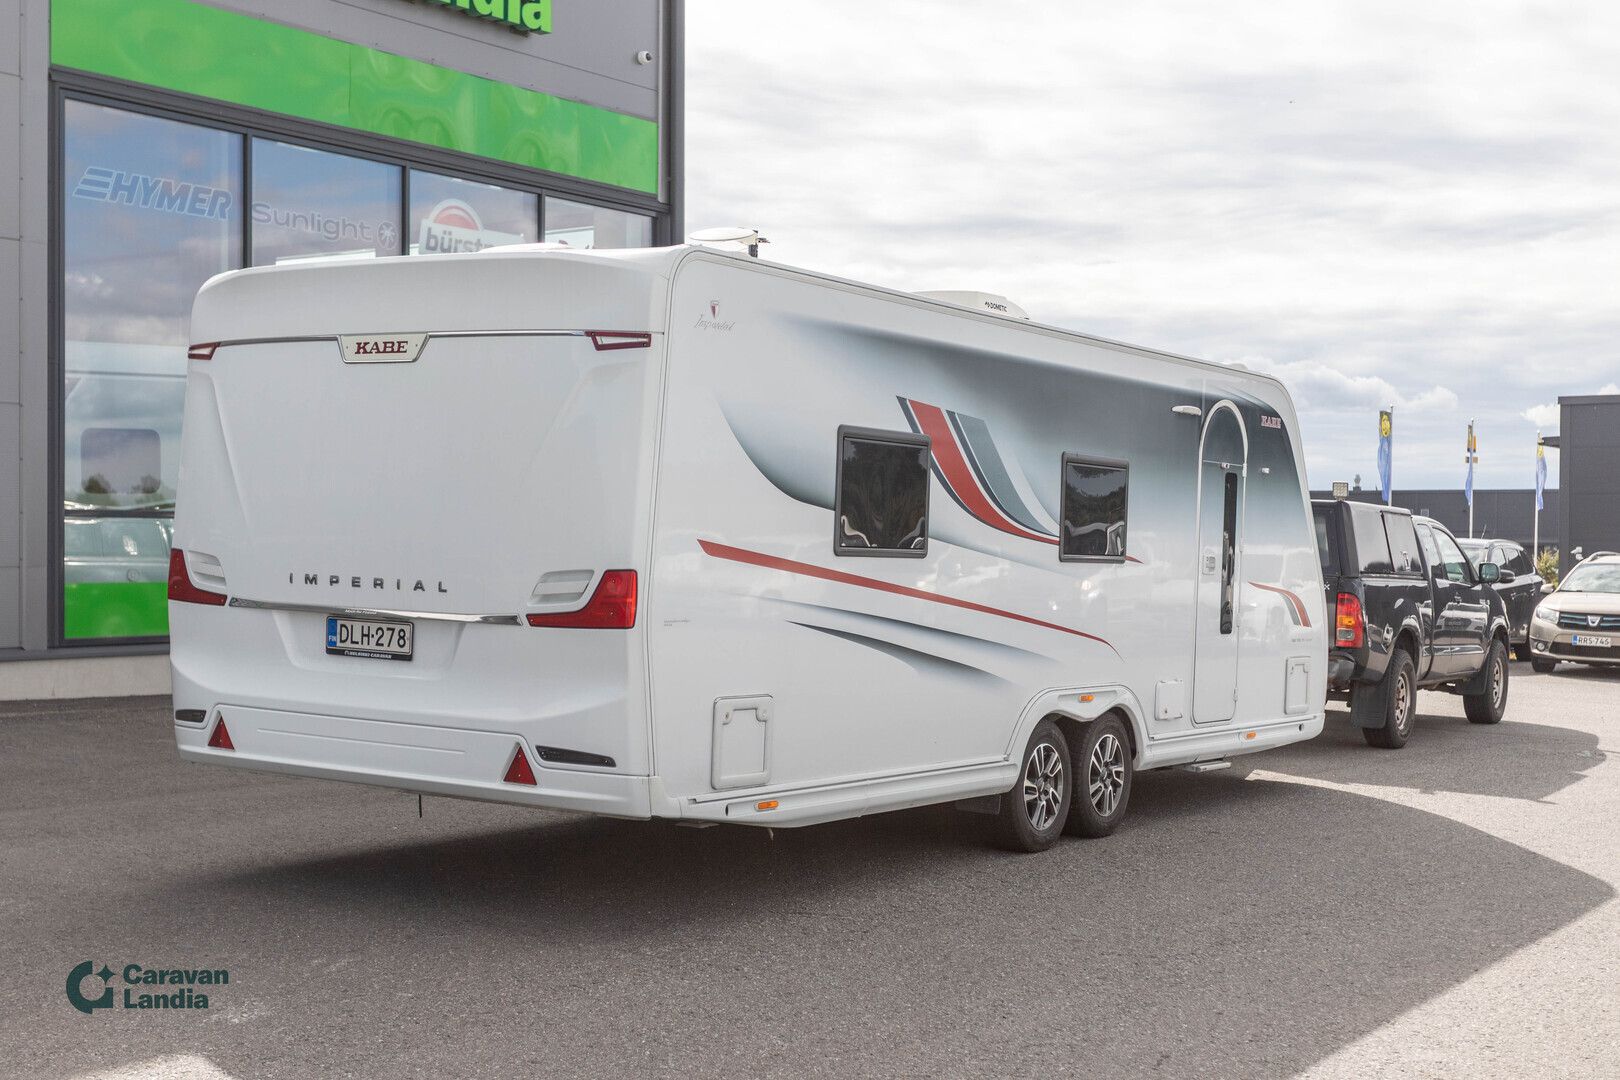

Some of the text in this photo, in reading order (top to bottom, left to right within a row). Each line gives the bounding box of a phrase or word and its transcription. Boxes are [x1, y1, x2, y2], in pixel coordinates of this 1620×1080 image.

[108, 171, 232, 220] HYMER
[252, 202, 372, 241] Sunlight
[426, 227, 494, 253] bürst
[355, 341, 408, 354] KABE
[289, 573, 447, 593] IMPERIAL
